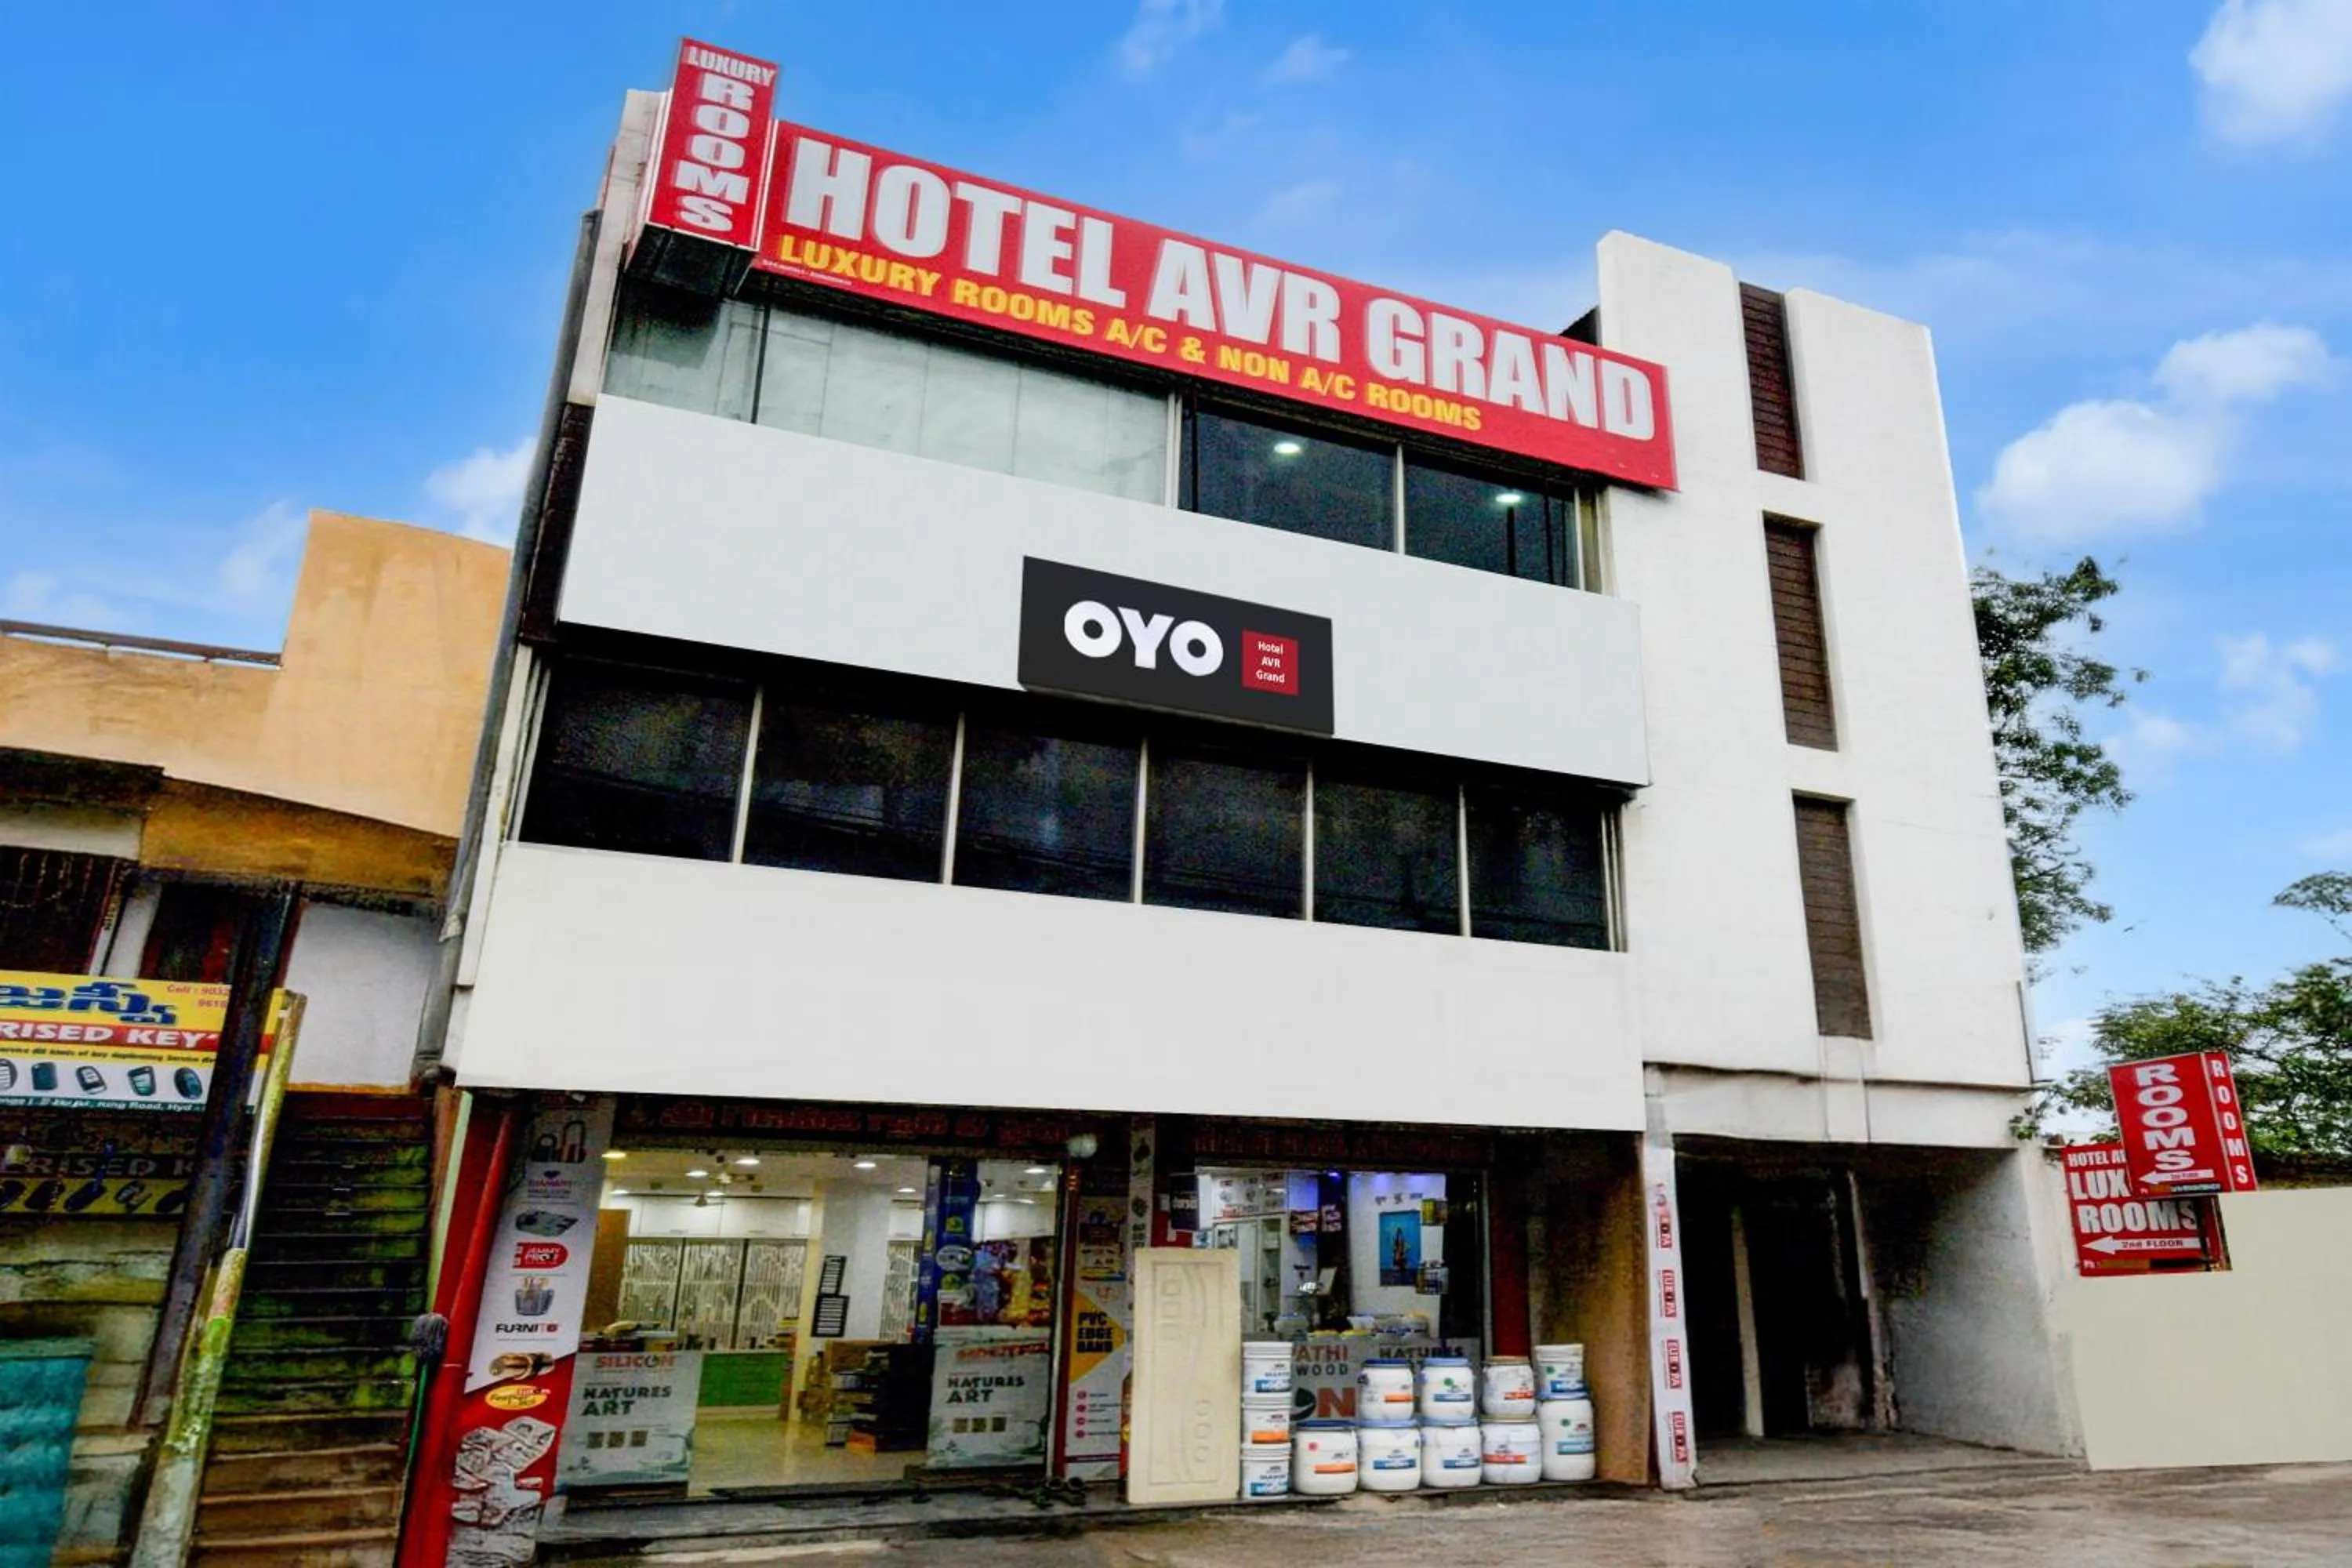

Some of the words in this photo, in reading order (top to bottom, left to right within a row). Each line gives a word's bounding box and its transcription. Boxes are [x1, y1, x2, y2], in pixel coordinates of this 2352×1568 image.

[688, 45, 777, 88] LUXURY
[673, 71, 754, 233] ROOMS
[786, 135, 1125, 309] HOTEL
[1147, 238, 1341, 363] AVR
[1365, 297, 1655, 441] GRAND
[779, 235, 941, 297] LUXURY
[953, 278, 1095, 336] ROOMS
[1105, 318, 1167, 357] A/C
[1180, 336, 1206, 364] &
[1218, 345, 1290, 383] NON
[1299, 365, 1356, 401] A/C
[1367, 385, 1482, 431] ROOMS
[1064, 600, 1224, 677] OYO
[1258, 641, 1283, 655] Hotel
[1261, 656, 1281, 669] AVR
[1256, 670, 1286, 684] Grand
[2135, 1063, 2196, 1171] ROOMS
[2211, 1059, 2249, 1184] ROOMS
[2067, 1151, 2110, 1167] HOTEL
[2078, 1201, 2198, 1234] ROOMS
[1298, 1363, 1348, 1376] WOOD
[947, 1374, 1025, 1389] NATURES
[583, 1386, 673, 1399] NATURES
[945, 1389, 994, 1404] ART
[581, 1400, 636, 1417] ART
